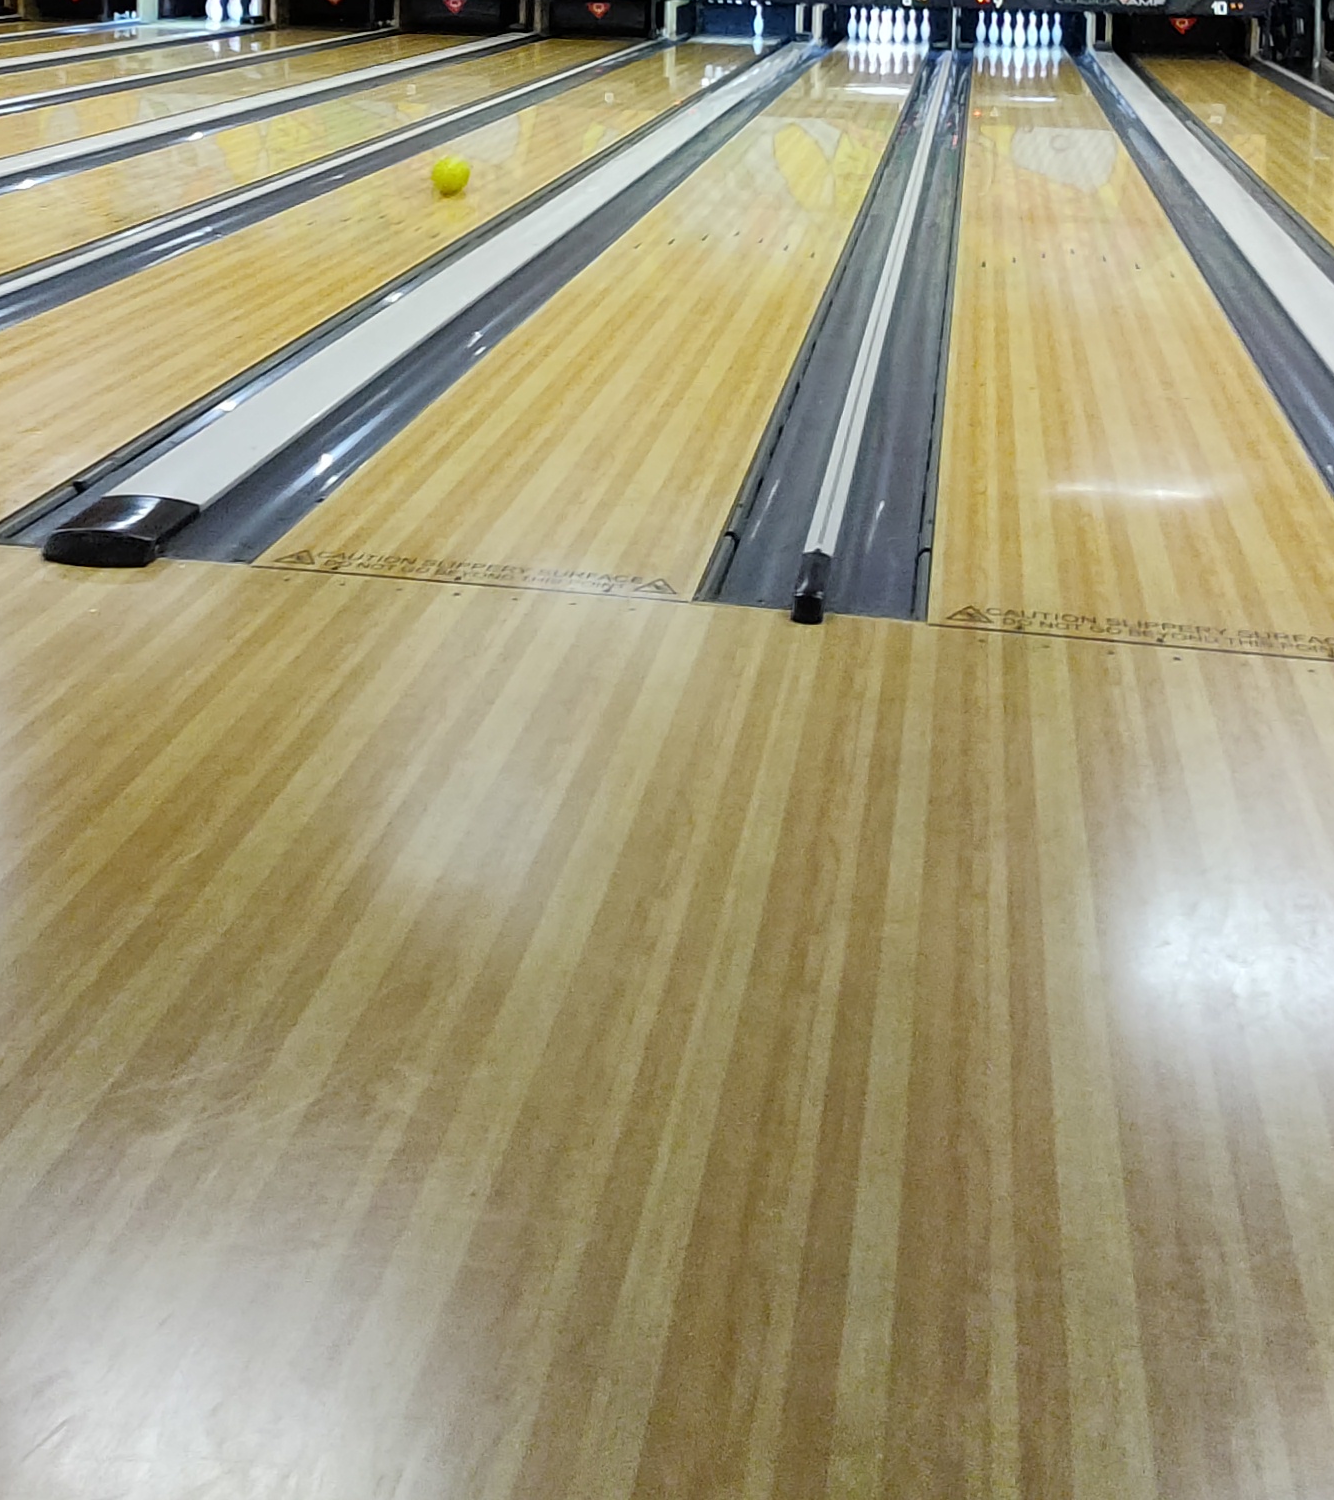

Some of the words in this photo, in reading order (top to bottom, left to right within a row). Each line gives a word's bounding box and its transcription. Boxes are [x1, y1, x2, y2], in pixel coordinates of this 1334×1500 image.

[1211, 0, 1229, 15] 10
[317, 551, 418, 566] CAUTION
[986, 606, 1097, 624] CAUTION
